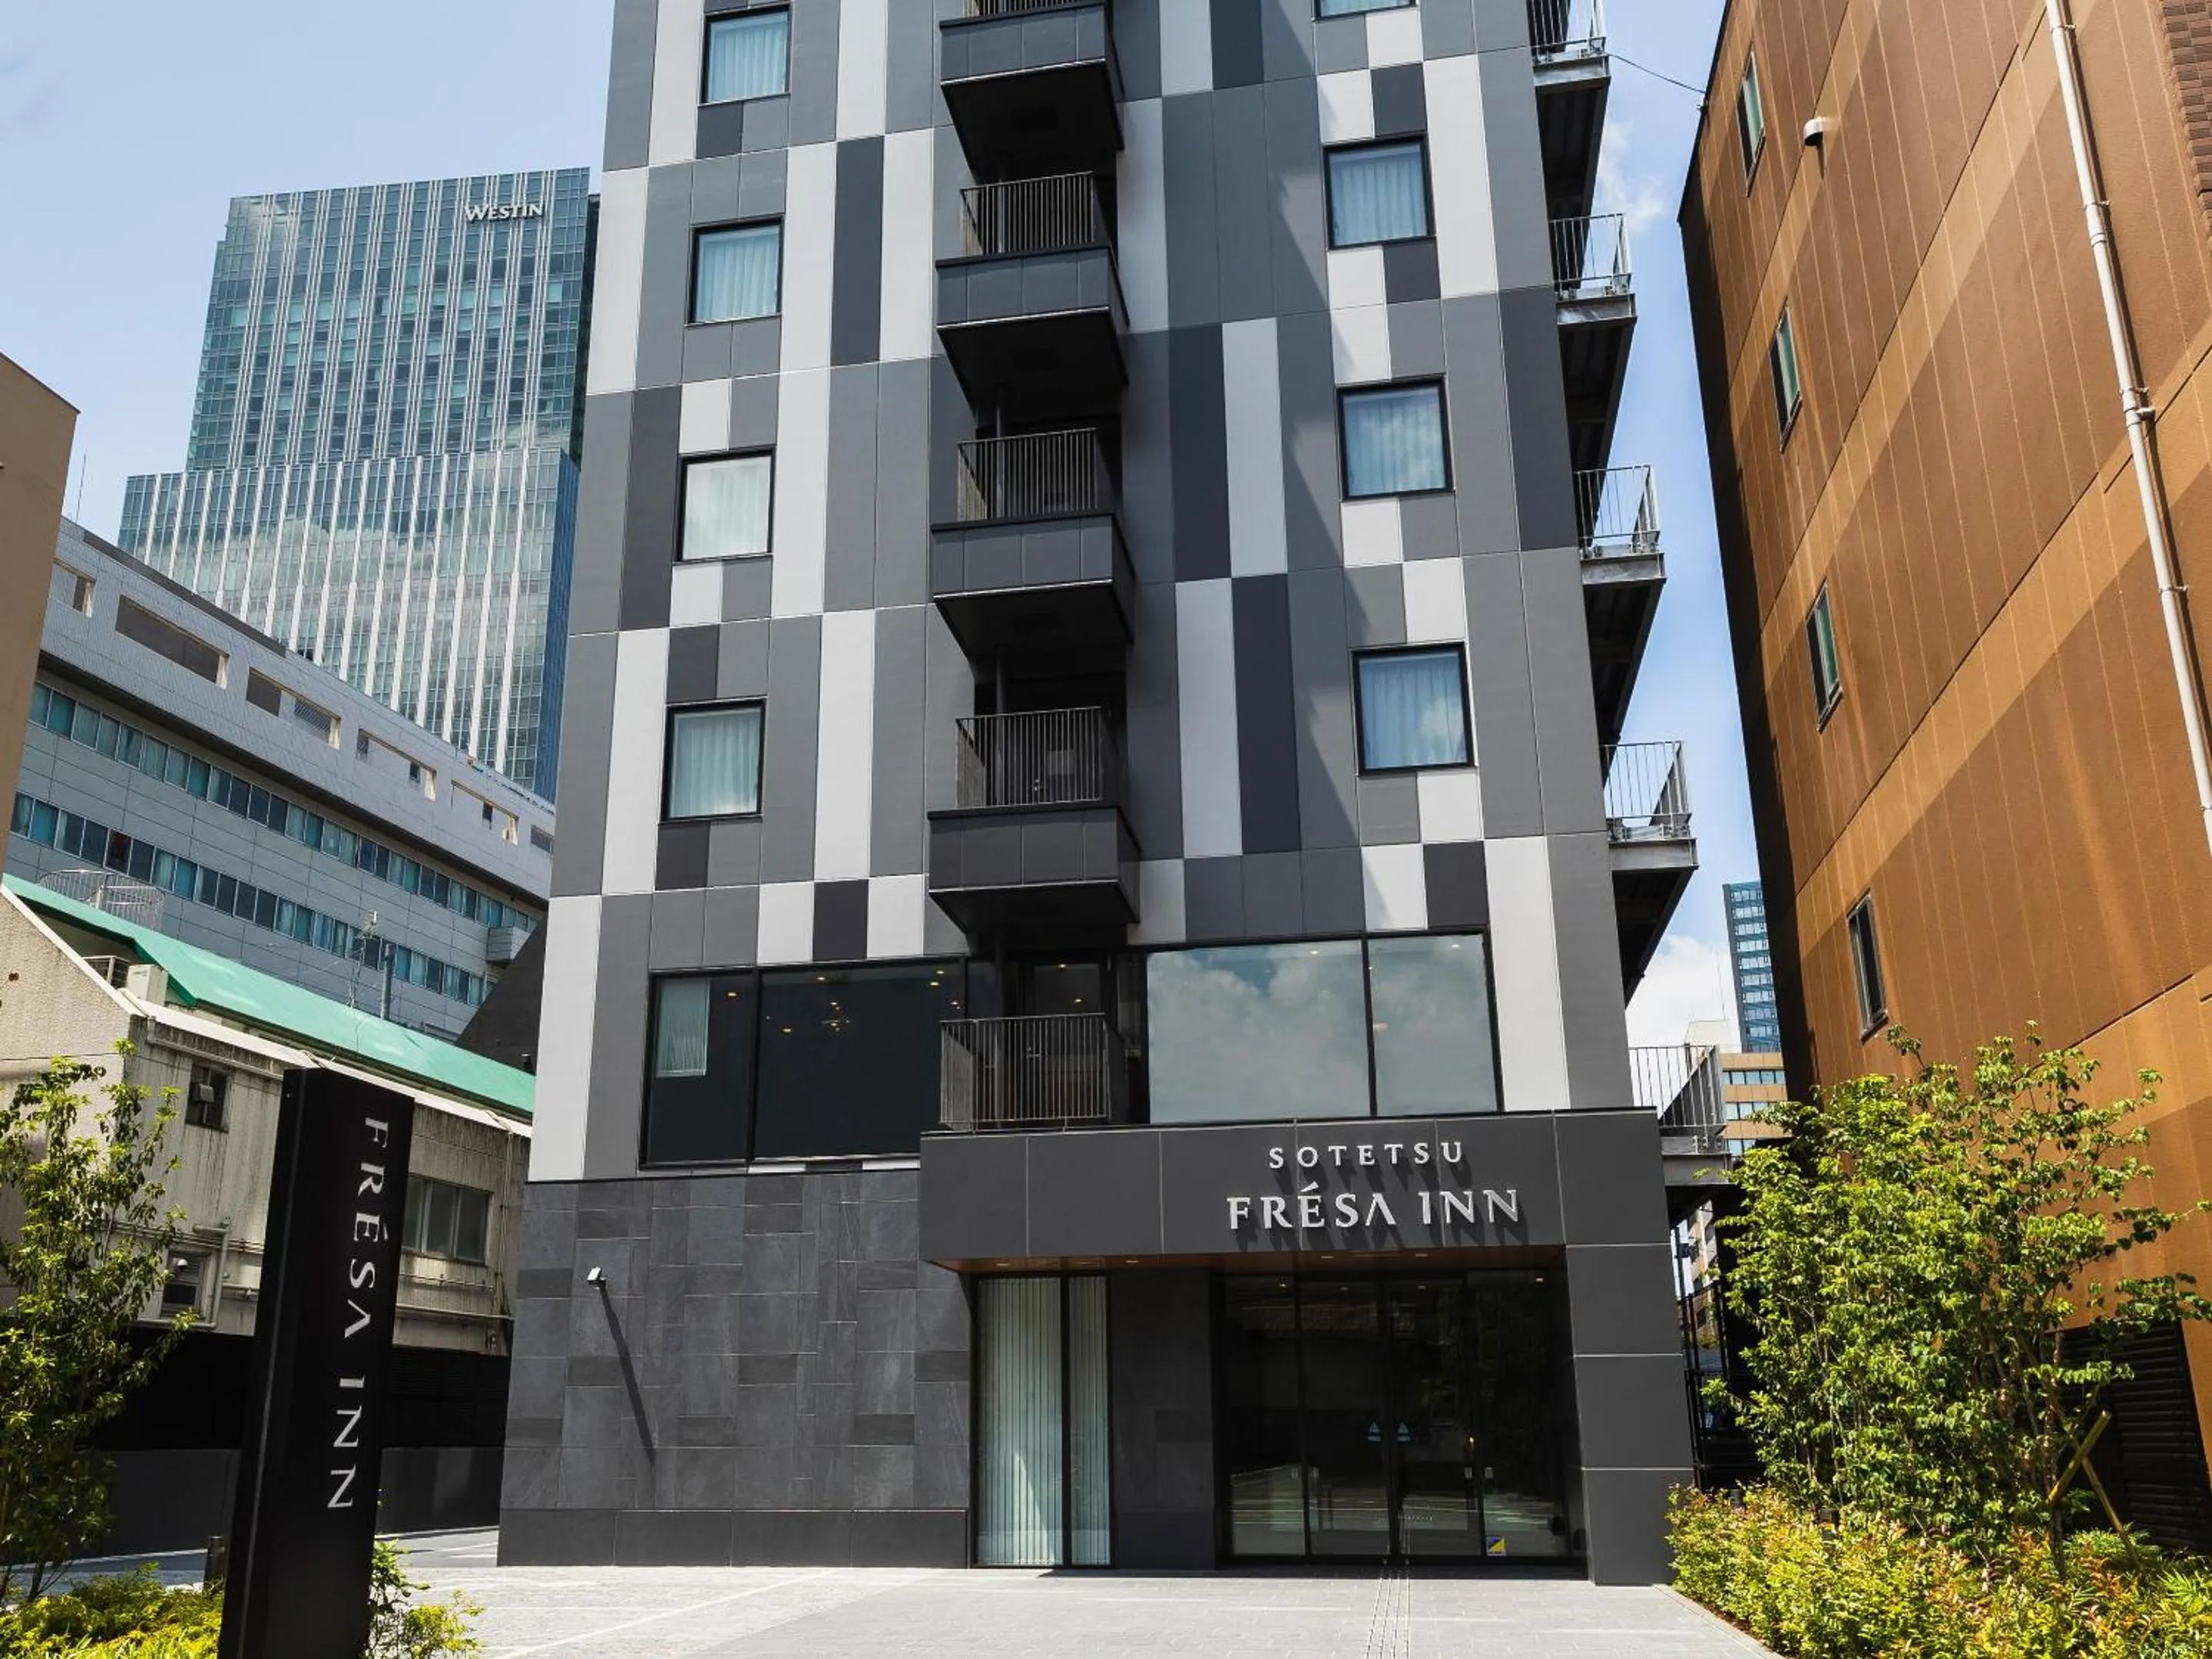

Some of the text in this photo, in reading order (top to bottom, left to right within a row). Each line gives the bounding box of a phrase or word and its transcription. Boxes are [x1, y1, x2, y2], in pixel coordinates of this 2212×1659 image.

[464, 202, 543, 221] WESTIN
[1268, 1141, 1462, 1169] SOTETSU
[1226, 1181, 1519, 1230] FRÉSA INN
[326, 1117, 389, 1509] FRÉSA INN
